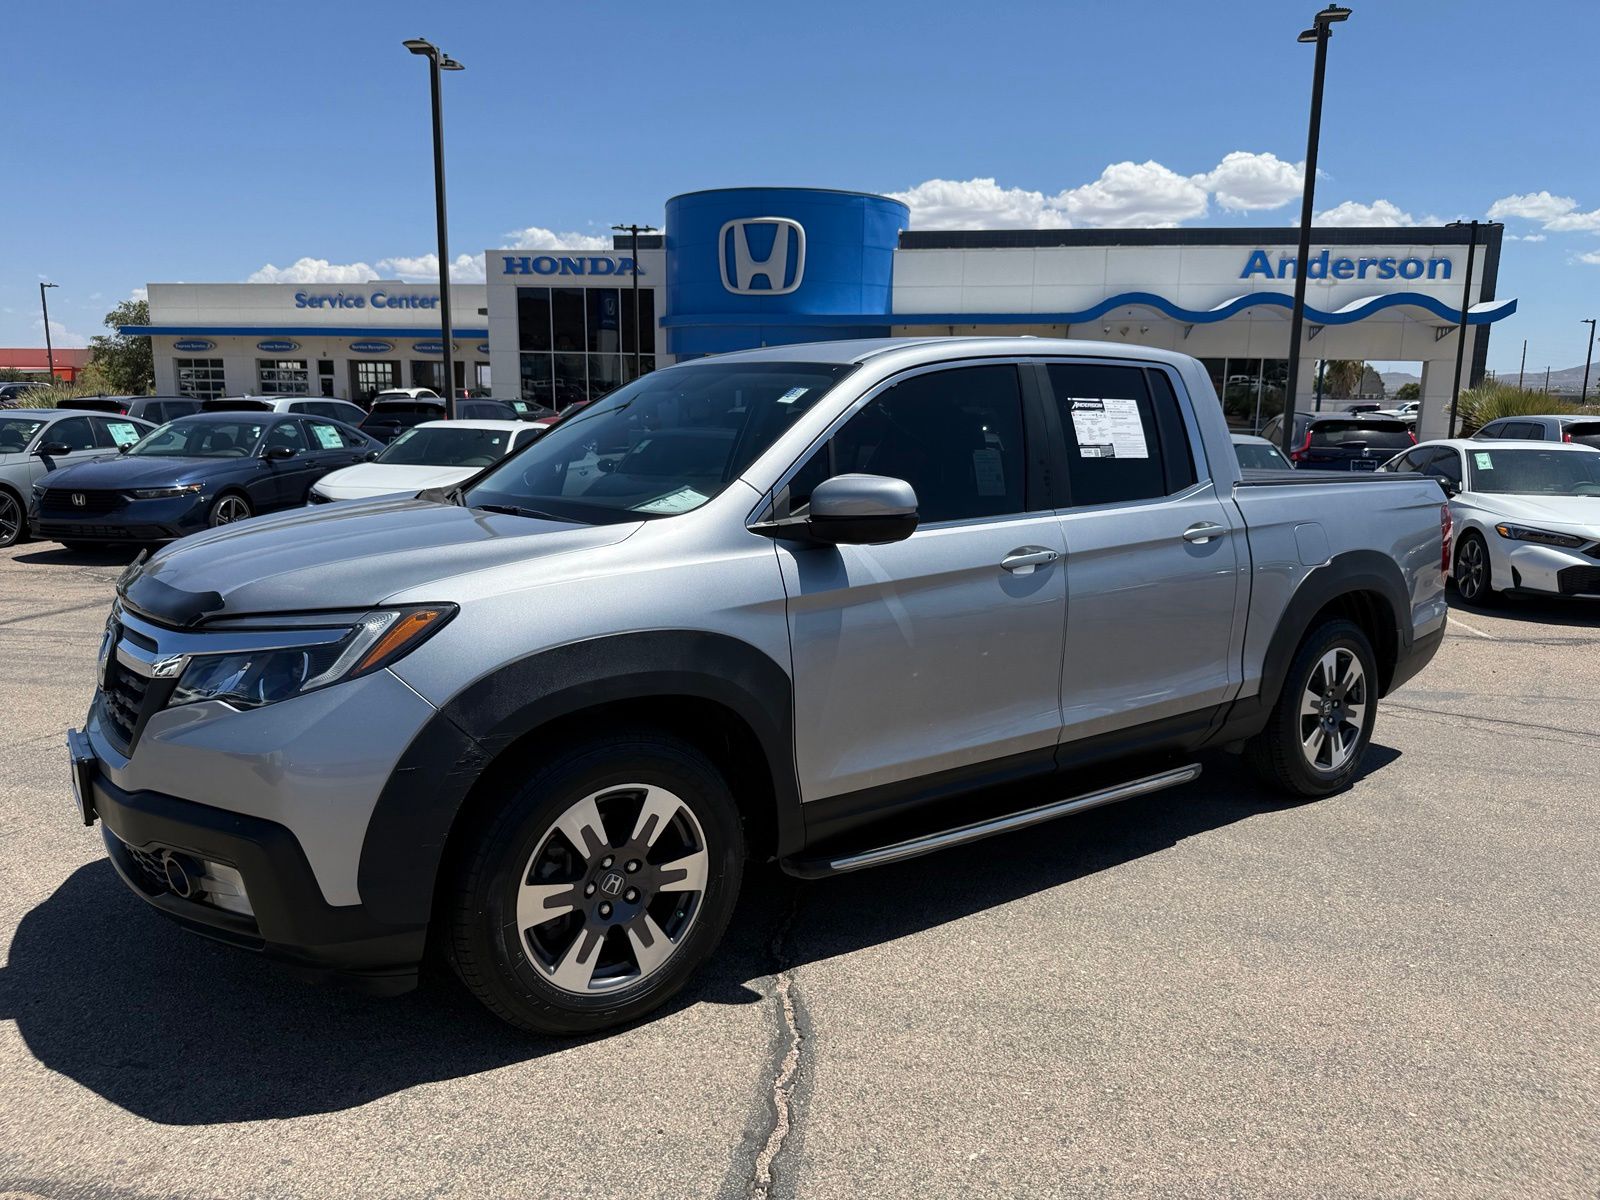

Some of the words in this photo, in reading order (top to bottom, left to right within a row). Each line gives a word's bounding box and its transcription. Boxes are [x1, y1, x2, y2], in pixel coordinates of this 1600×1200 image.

[502, 256, 646, 276] HONDA
[1239, 249, 1453, 280] Anderson
[294, 291, 366, 309] Service
[370, 291, 440, 309] Center
